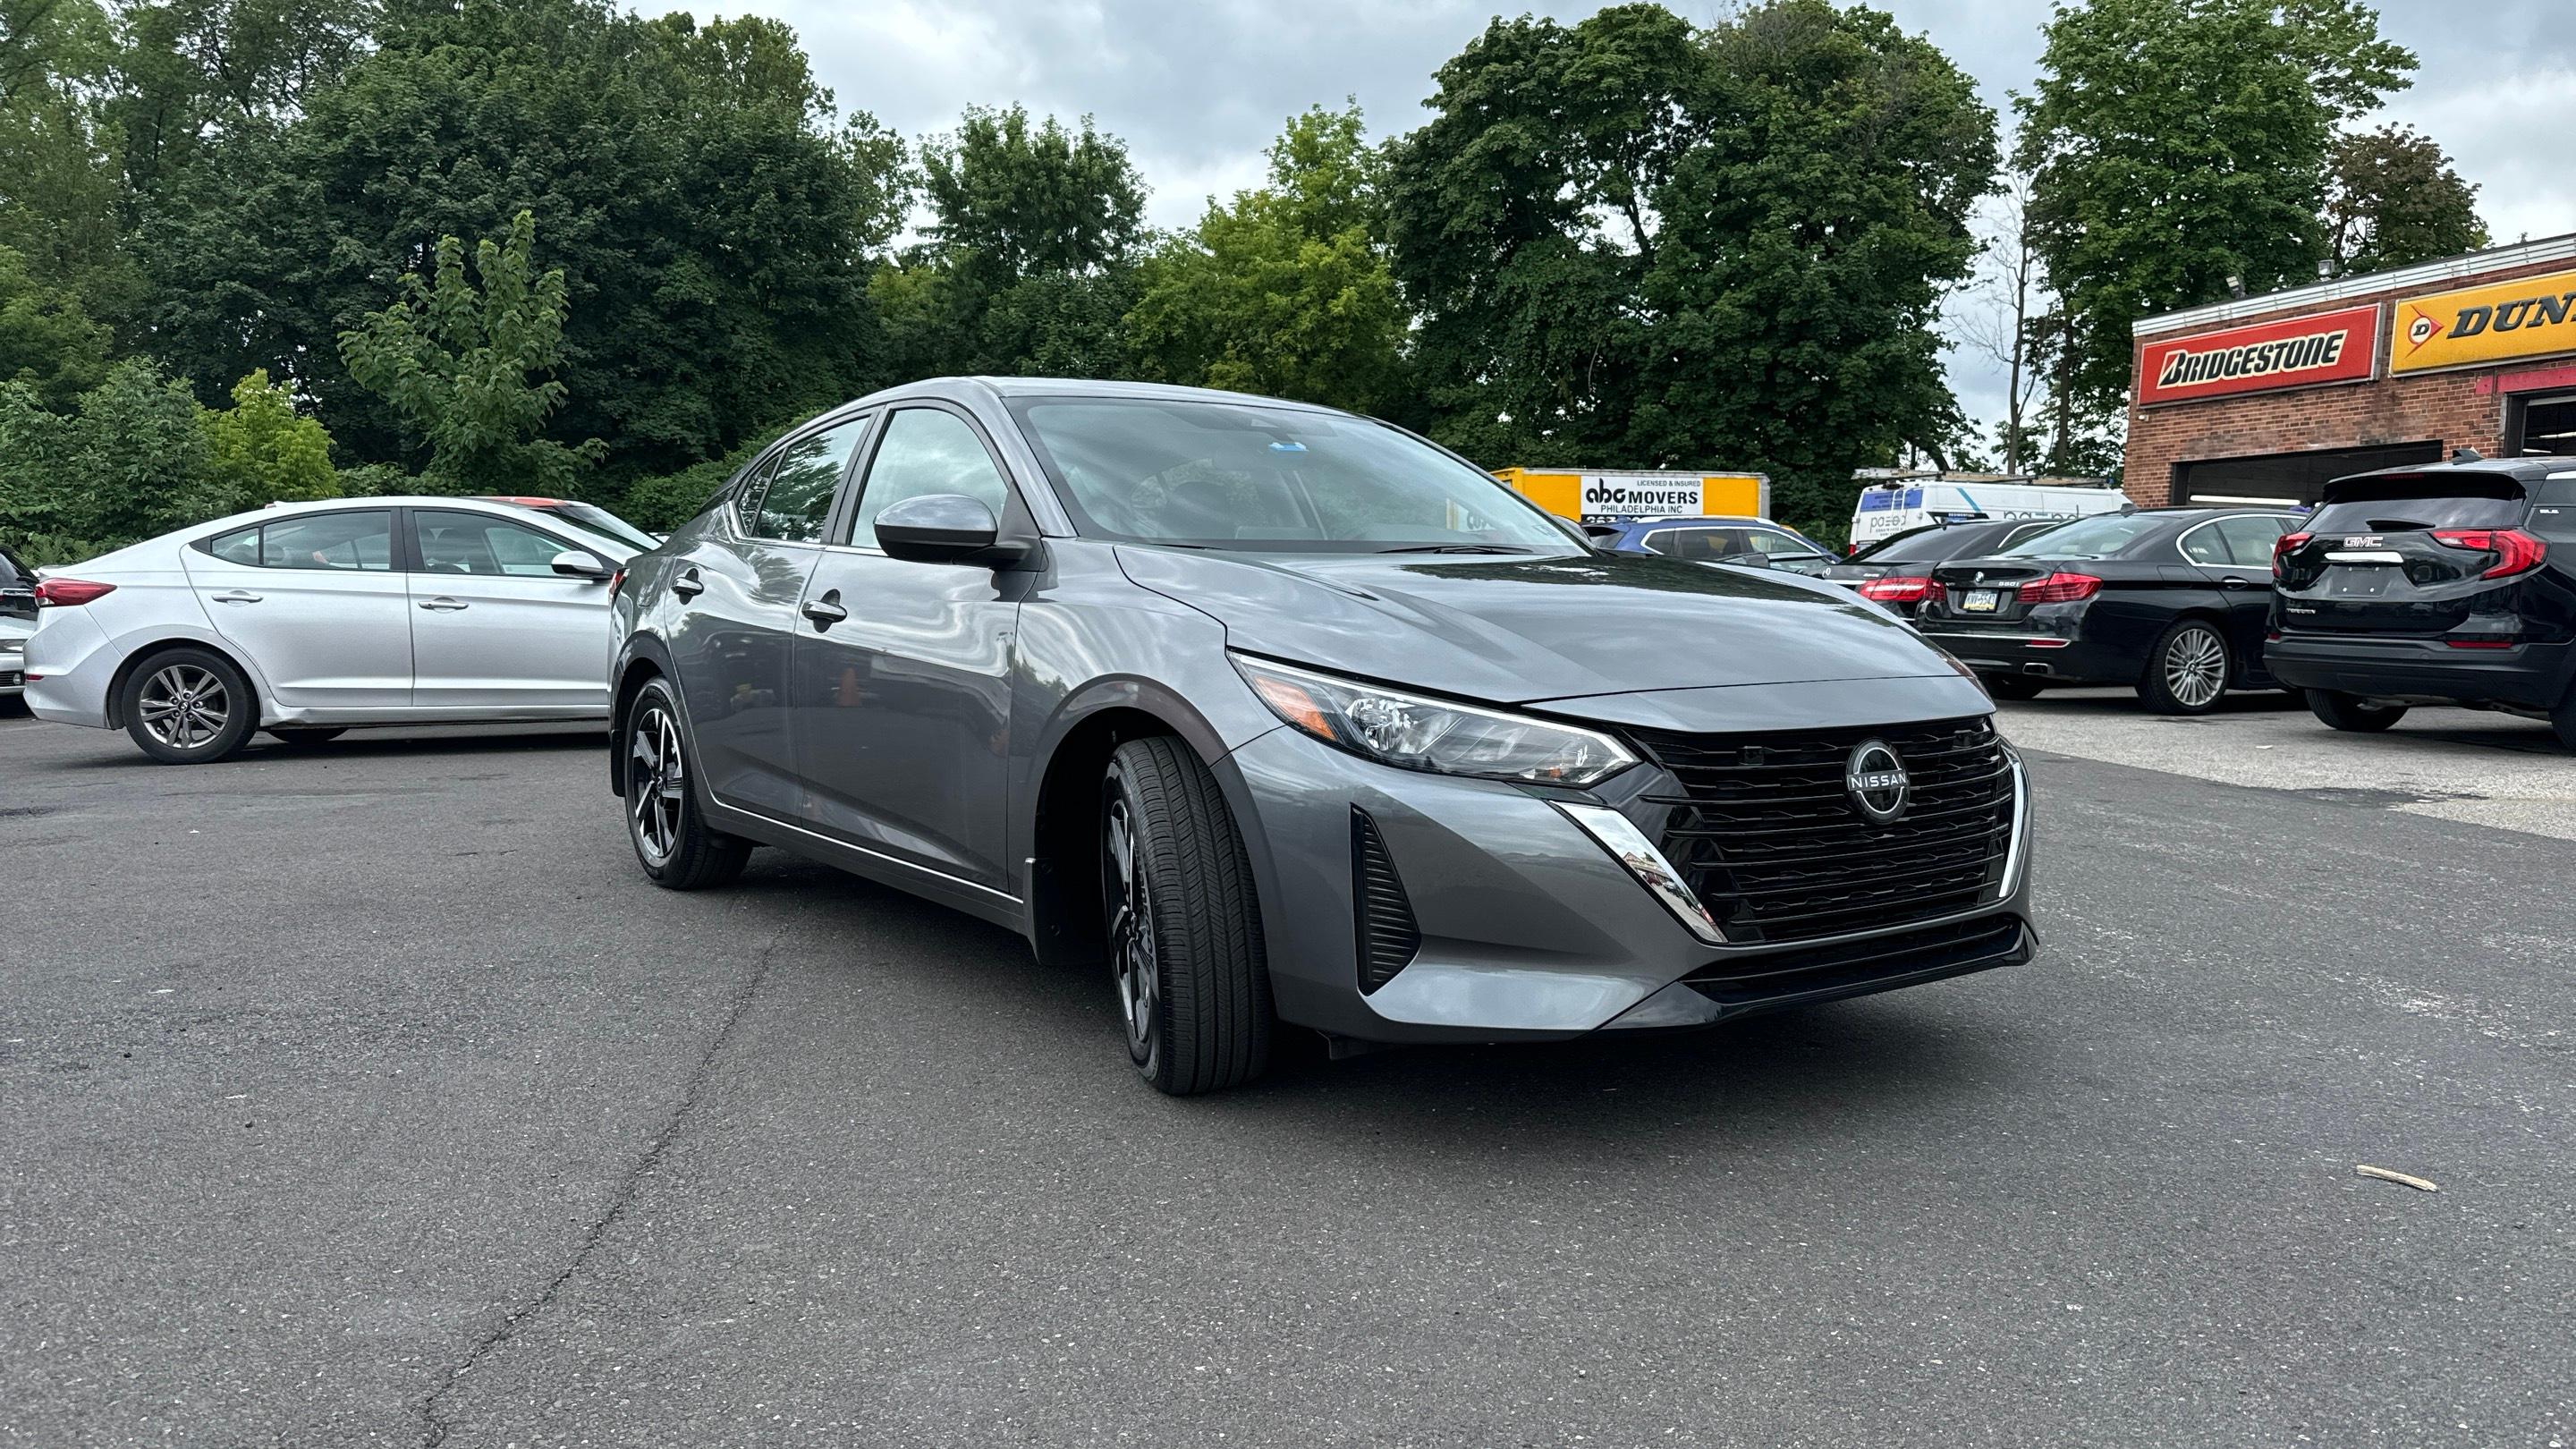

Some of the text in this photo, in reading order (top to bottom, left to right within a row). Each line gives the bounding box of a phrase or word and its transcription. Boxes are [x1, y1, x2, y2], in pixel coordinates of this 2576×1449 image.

[2446, 292, 2576, 339] DUN
[2158, 333, 2344, 387] BRIDGESTONE
[1586, 478, 1698, 504] abc MOVERS
[1600, 504, 1683, 513] PHILADELPHIA INC
[2343, 536, 2384, 547] GMC
[1851, 773, 1906, 789] NISSAN
